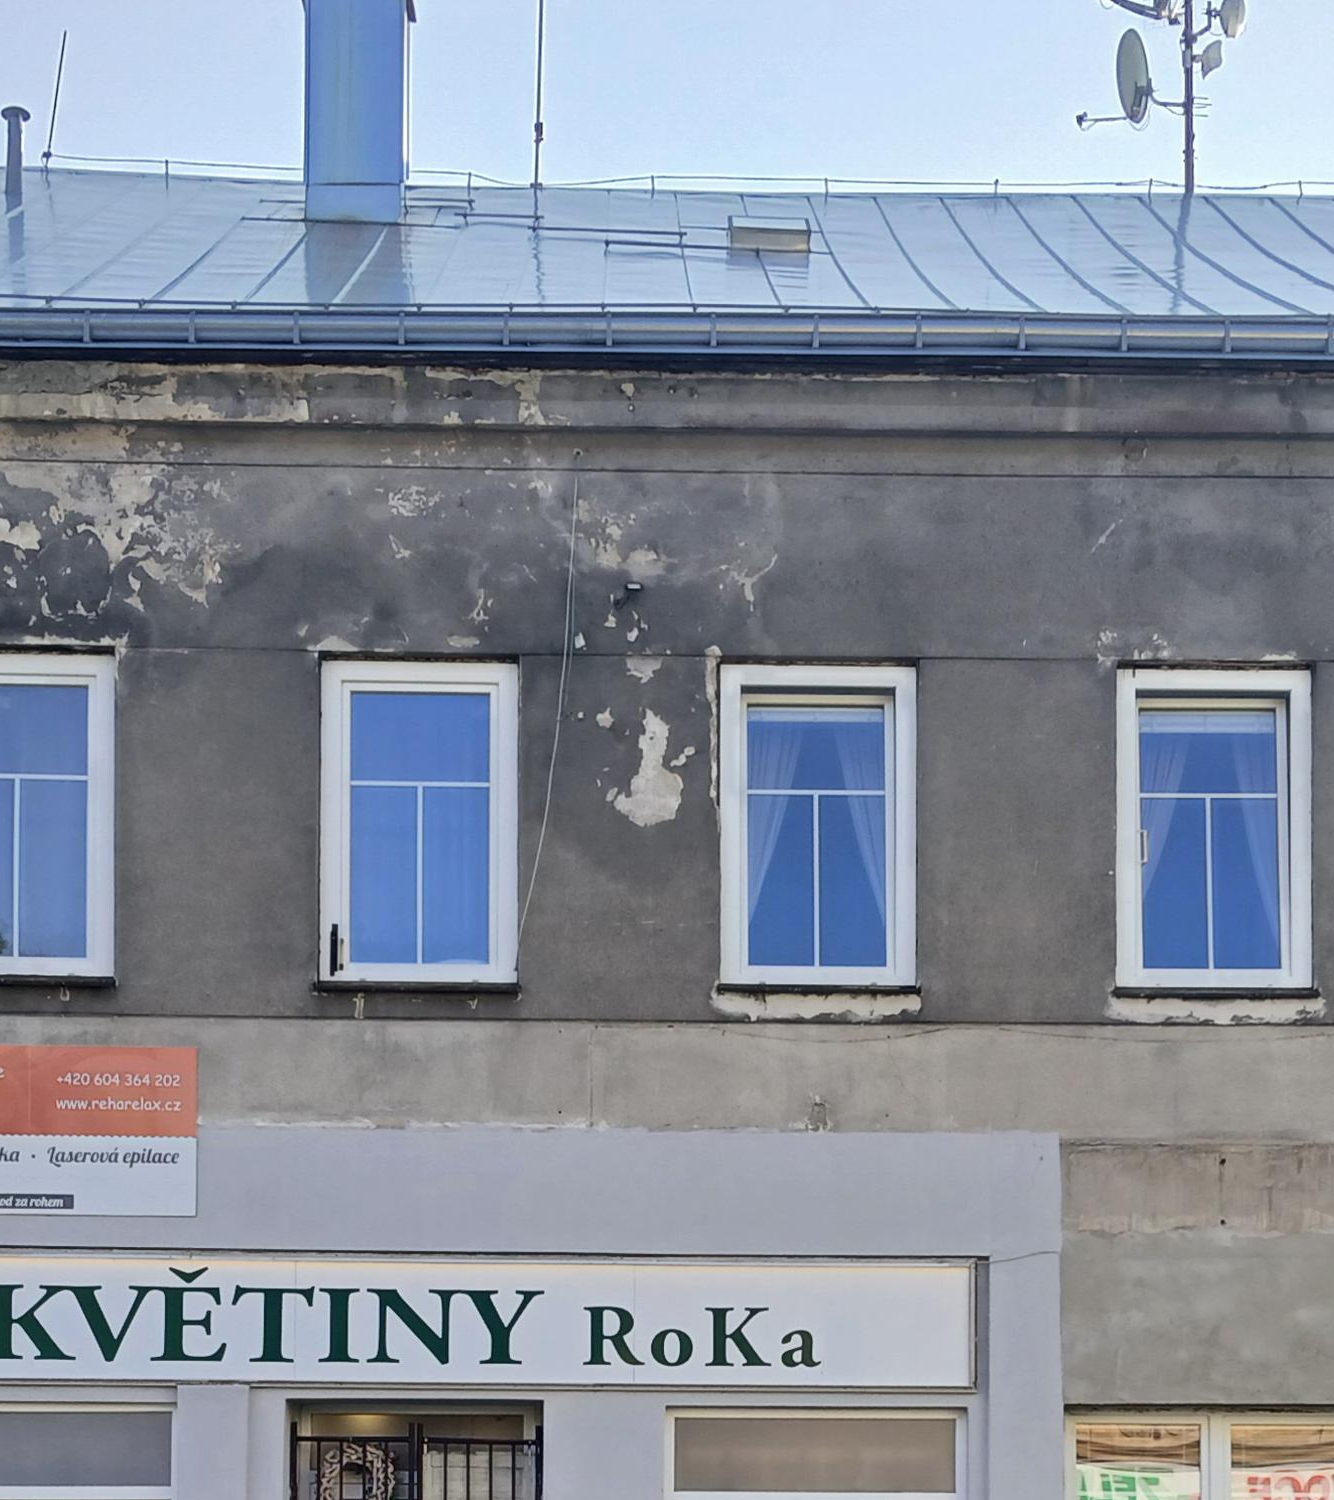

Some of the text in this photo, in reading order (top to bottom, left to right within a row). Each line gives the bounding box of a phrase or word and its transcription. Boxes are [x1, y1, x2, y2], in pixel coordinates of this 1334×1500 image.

[56, 1072, 181, 1087] +420 604 364 202
[55, 1096, 182, 1112] www.reharelax.cz
[47, 1146, 120, 1168] Laserová
[122, 1148, 180, 1168] epilace
[14, 1198, 28, 1208] za
[29, 1196, 64, 1208] rohem
[583, 1307, 821, 1367] RoKa
